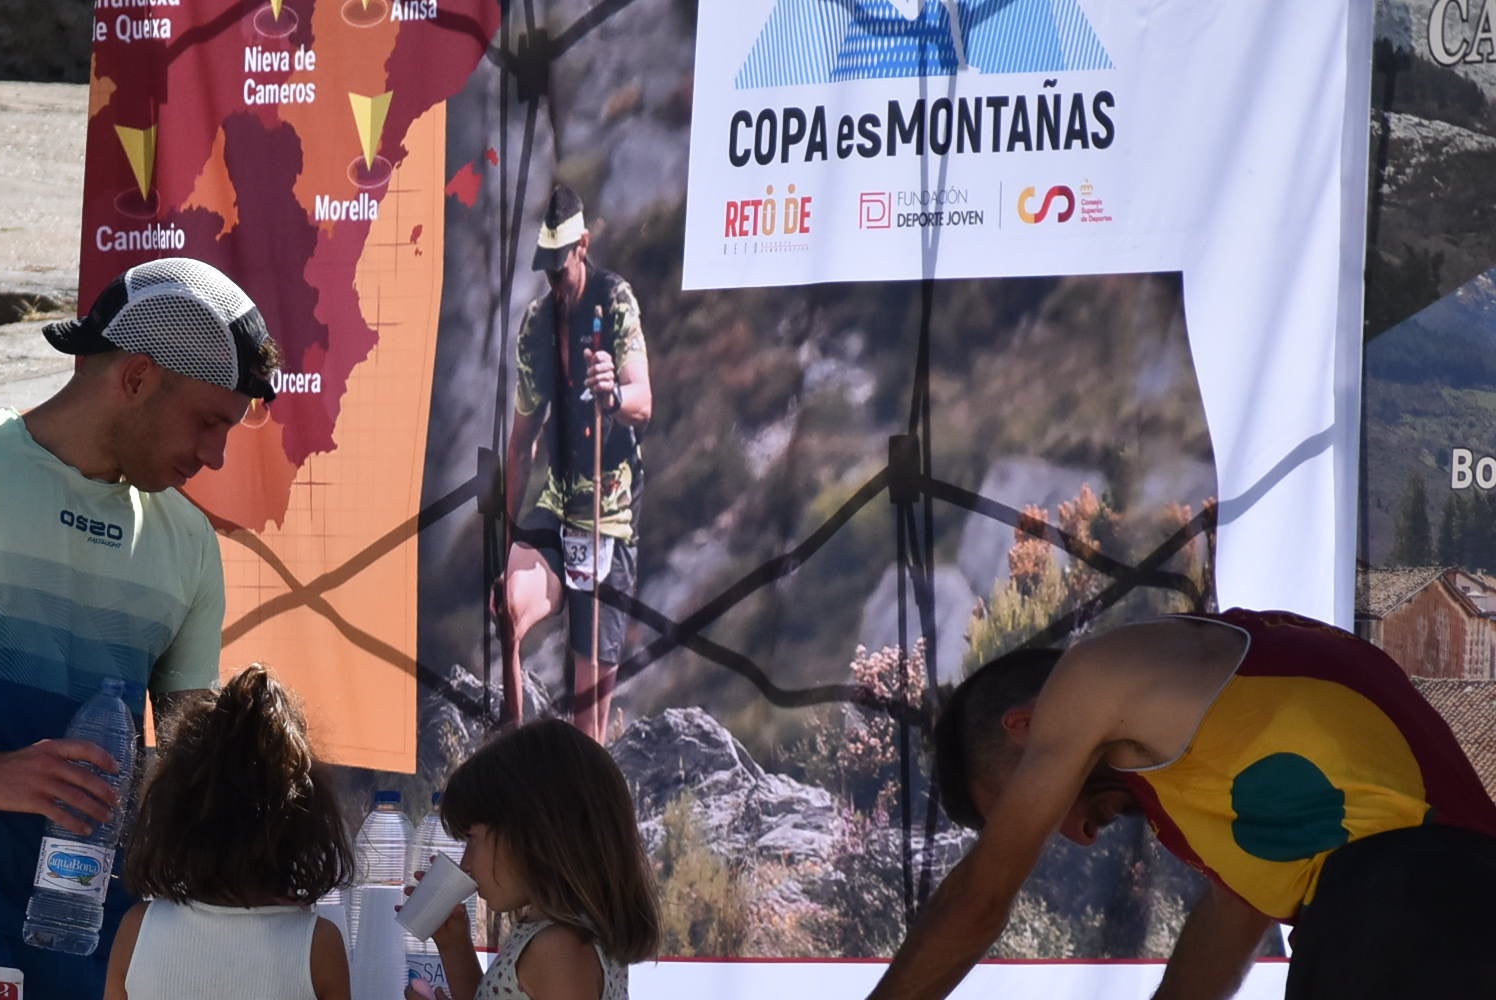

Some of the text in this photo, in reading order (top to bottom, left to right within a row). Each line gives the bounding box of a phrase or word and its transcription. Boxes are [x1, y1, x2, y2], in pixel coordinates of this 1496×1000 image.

[115, 13, 171, 43] Queixa
[244, 44, 316, 72] Nieva de
[243, 78, 315, 104] Cameros
[728, 105, 827, 168] COPA
[314, 194, 378, 221] Morella
[898, 186, 968, 206] FUNDACIÓN
[725, 196, 813, 237] RETO DE
[897, 210, 984, 227] DEPORTE JOVEN
[96, 223, 185, 251] Candelario
[271, 368, 321, 393] Orcera
[424, 963, 444, 984] SA
